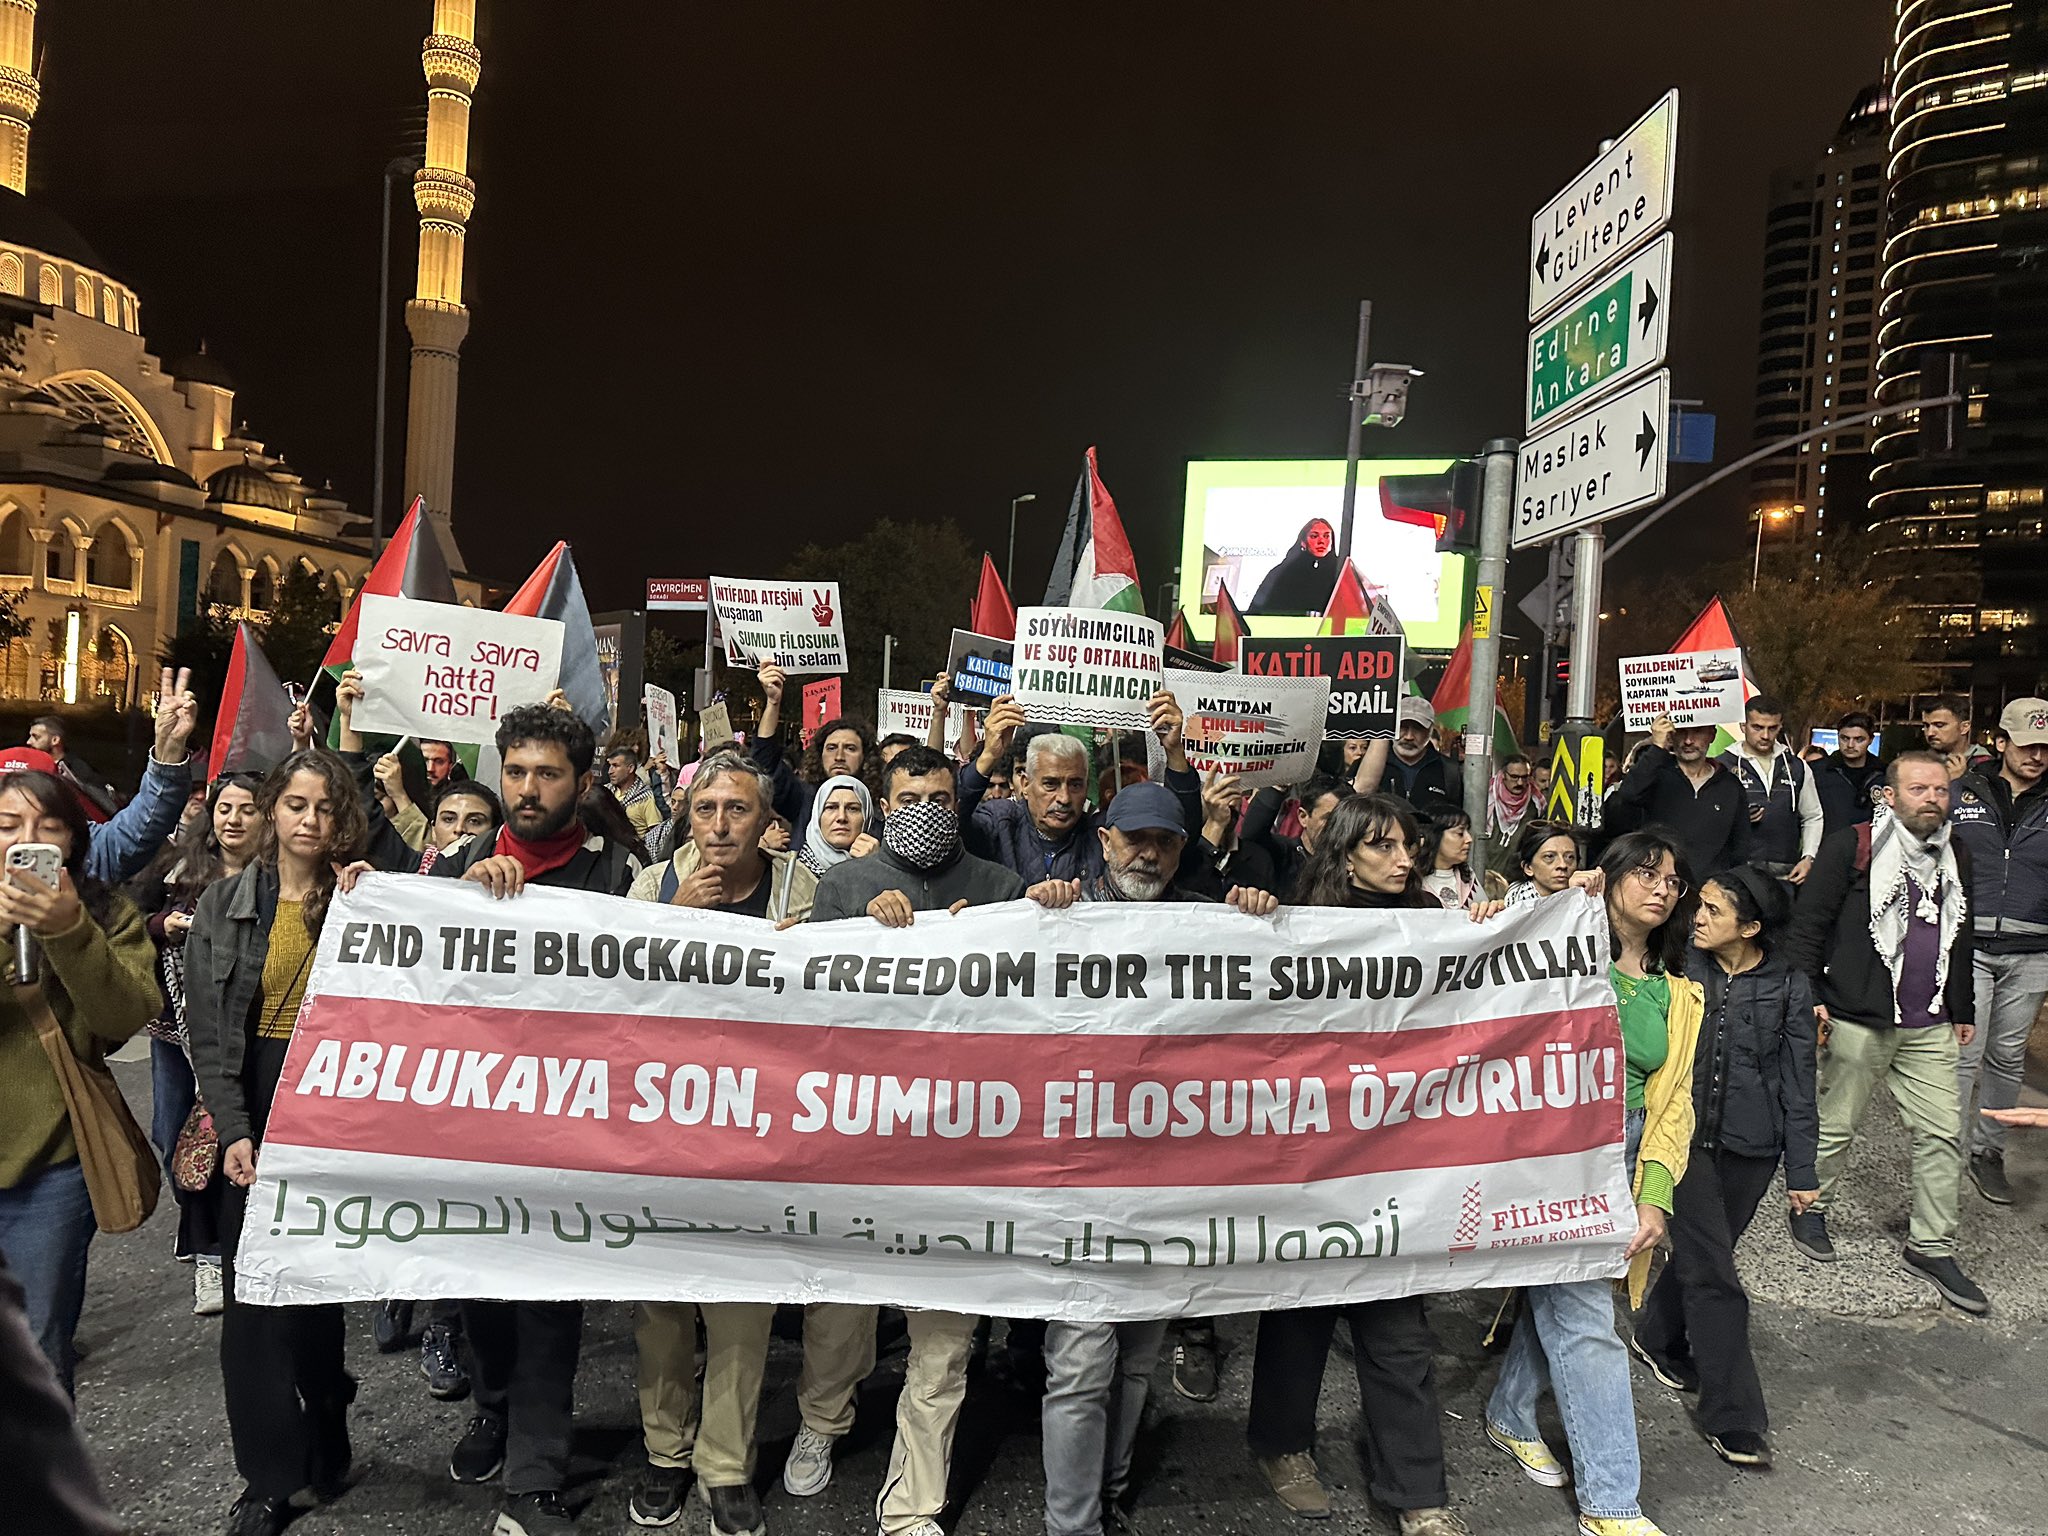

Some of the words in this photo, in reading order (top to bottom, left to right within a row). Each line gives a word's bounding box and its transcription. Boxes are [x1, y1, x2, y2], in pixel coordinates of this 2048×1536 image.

[1553, 149, 1634, 241] Levent
[1552, 194, 1647, 284] Gültepe
[1534, 297, 1619, 373] Edirne
[1533, 341, 1622, 416] Ankara
[1524, 420, 1608, 484] Maslak
[1521, 469, 1612, 527] Sarıyer
[650, 582, 702, 594] ÇAYIRÇİMEN
[714, 583, 759, 605] İNTİFADA
[761, 588, 803, 611] ATEŞİNİ
[717, 603, 763, 625] kuşanan
[738, 630, 776, 649] SUMUD
[780, 631, 840, 650] FİLOSUNA
[1028, 617, 1155, 648] SOYKIRIMCILAR
[381, 628, 451, 658] savra
[471, 641, 541, 672] savra
[773, 652, 795, 667] bin
[799, 652, 842, 667] selam
[1024, 644, 1042, 661] VE
[1048, 644, 1078, 669] SUÇ
[1083, 647, 1161, 673] ORTAKLARI
[1246, 643, 1329, 677] KATİL
[1337, 651, 1394, 680] ABD
[424, 665, 496, 694] hatta
[968, 658, 998, 674] KATİL
[1624, 656, 1694, 675] KIZILDENİZ'İ
[1625, 675, 1676, 688] SOYKIRIMA
[1626, 688, 1669, 699] KAPATAN
[421, 692, 498, 721] nasr!
[1627, 701, 1666, 714] YEMEN
[1669, 697, 1721, 711] HALKINA
[1201, 717, 1266, 735] ÇIKILSIN
[1221, 742, 1240, 757] VE
[1243, 738, 1307, 758] KÜRECİK
[337, 922, 423, 968] END
[439, 926, 517, 975] THE
[533, 930, 785, 995] BLOCKADE,
[803, 951, 1037, 998] FREEDOM
[1054, 953, 1148, 999] FOR
[1164, 954, 1252, 1001] THE
[1268, 955, 1423, 1001] SUMUD
[1431, 935, 1597, 997] FLOTILLA!
[295, 1038, 610, 1121] ABLUKAYA
[628, 1061, 773, 1138] SON,
[791, 1070, 1021, 1139] SUMUD
[1042, 1069, 1332, 1139] FİLOSUNA
[1348, 1042, 1616, 1132] ÖZGÜRLÜK!
[1491, 1193, 1611, 1232] FİLİSTİN
[1490, 1234, 1544, 1249] EYLEM
[1549, 1219, 1617, 1243] KOMİTESİ
